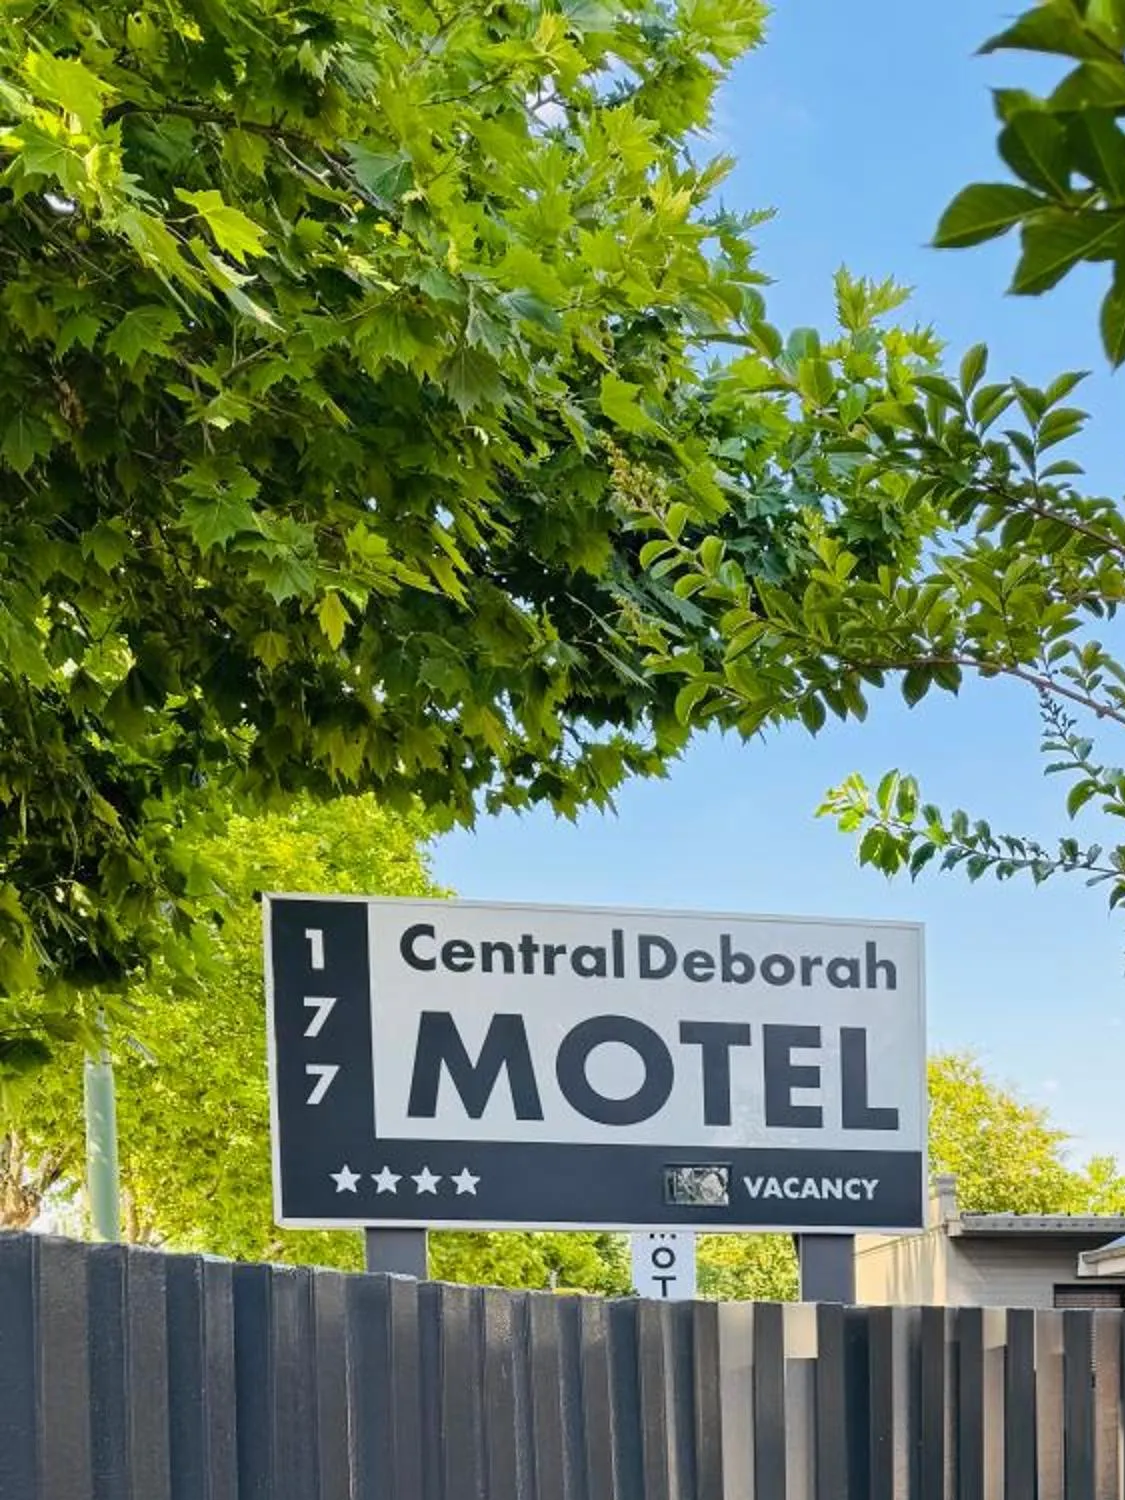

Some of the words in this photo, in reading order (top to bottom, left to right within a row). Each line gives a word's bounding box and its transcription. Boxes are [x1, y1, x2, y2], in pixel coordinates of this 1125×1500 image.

[407, 1010, 899, 1129] MOTEL
[743, 1176, 879, 1200] VACANCY
[650, 1233, 676, 1297] OT
